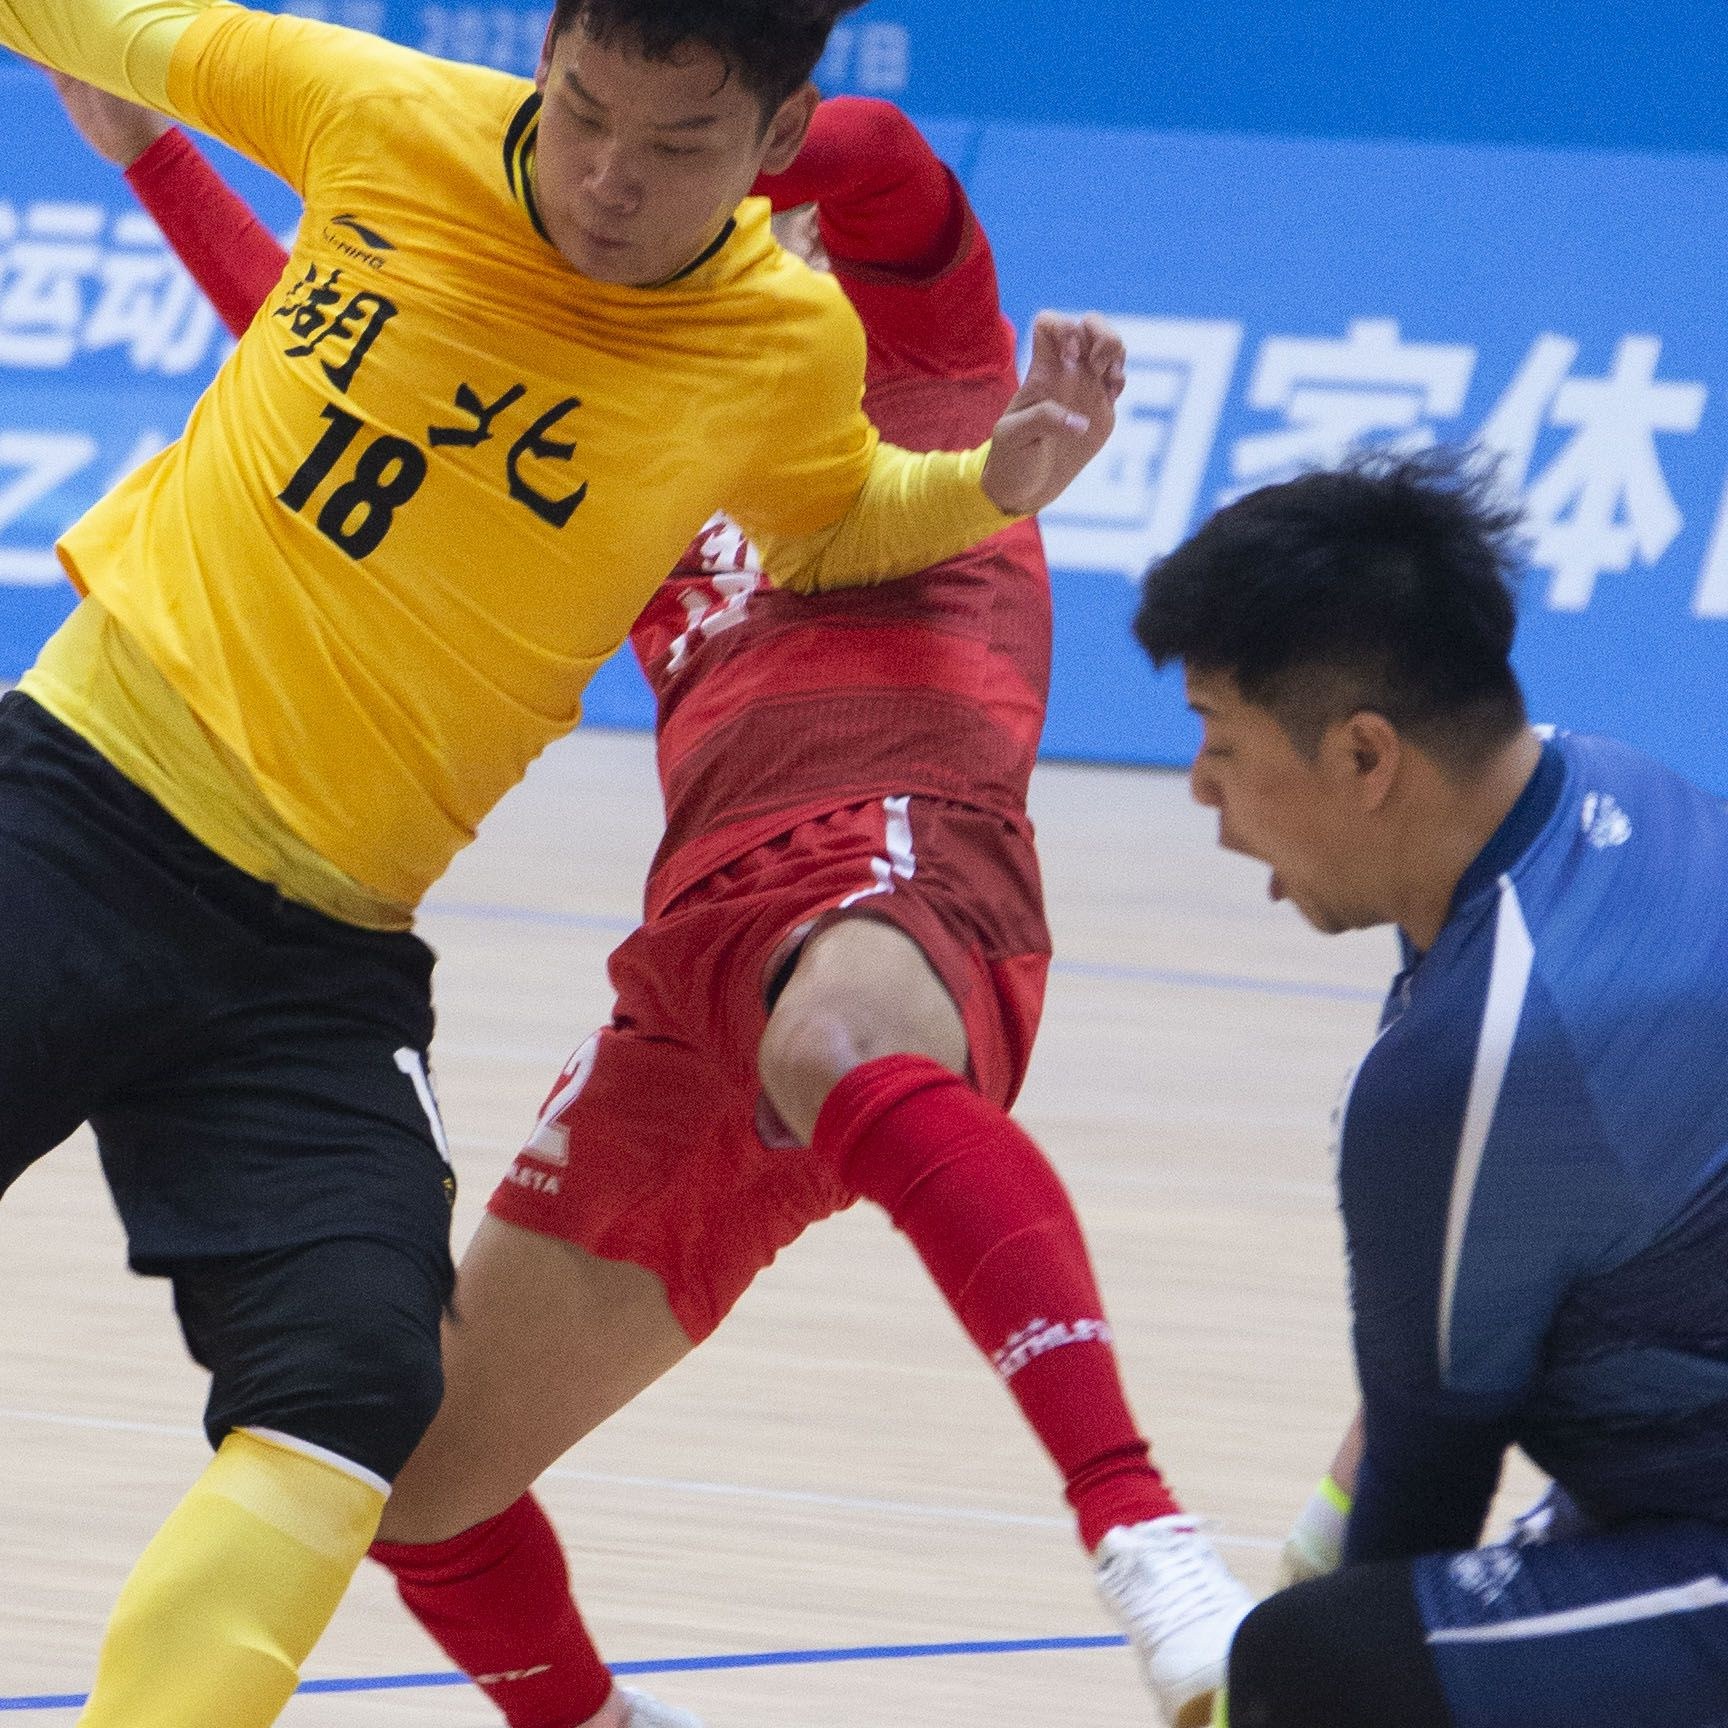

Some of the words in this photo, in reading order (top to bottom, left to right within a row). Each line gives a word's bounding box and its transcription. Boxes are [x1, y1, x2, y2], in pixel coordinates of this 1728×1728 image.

[273, 263, 589, 529] 湖北
[275, 404, 428, 562] 18
[1020, 310, 1728, 620] 国家体
